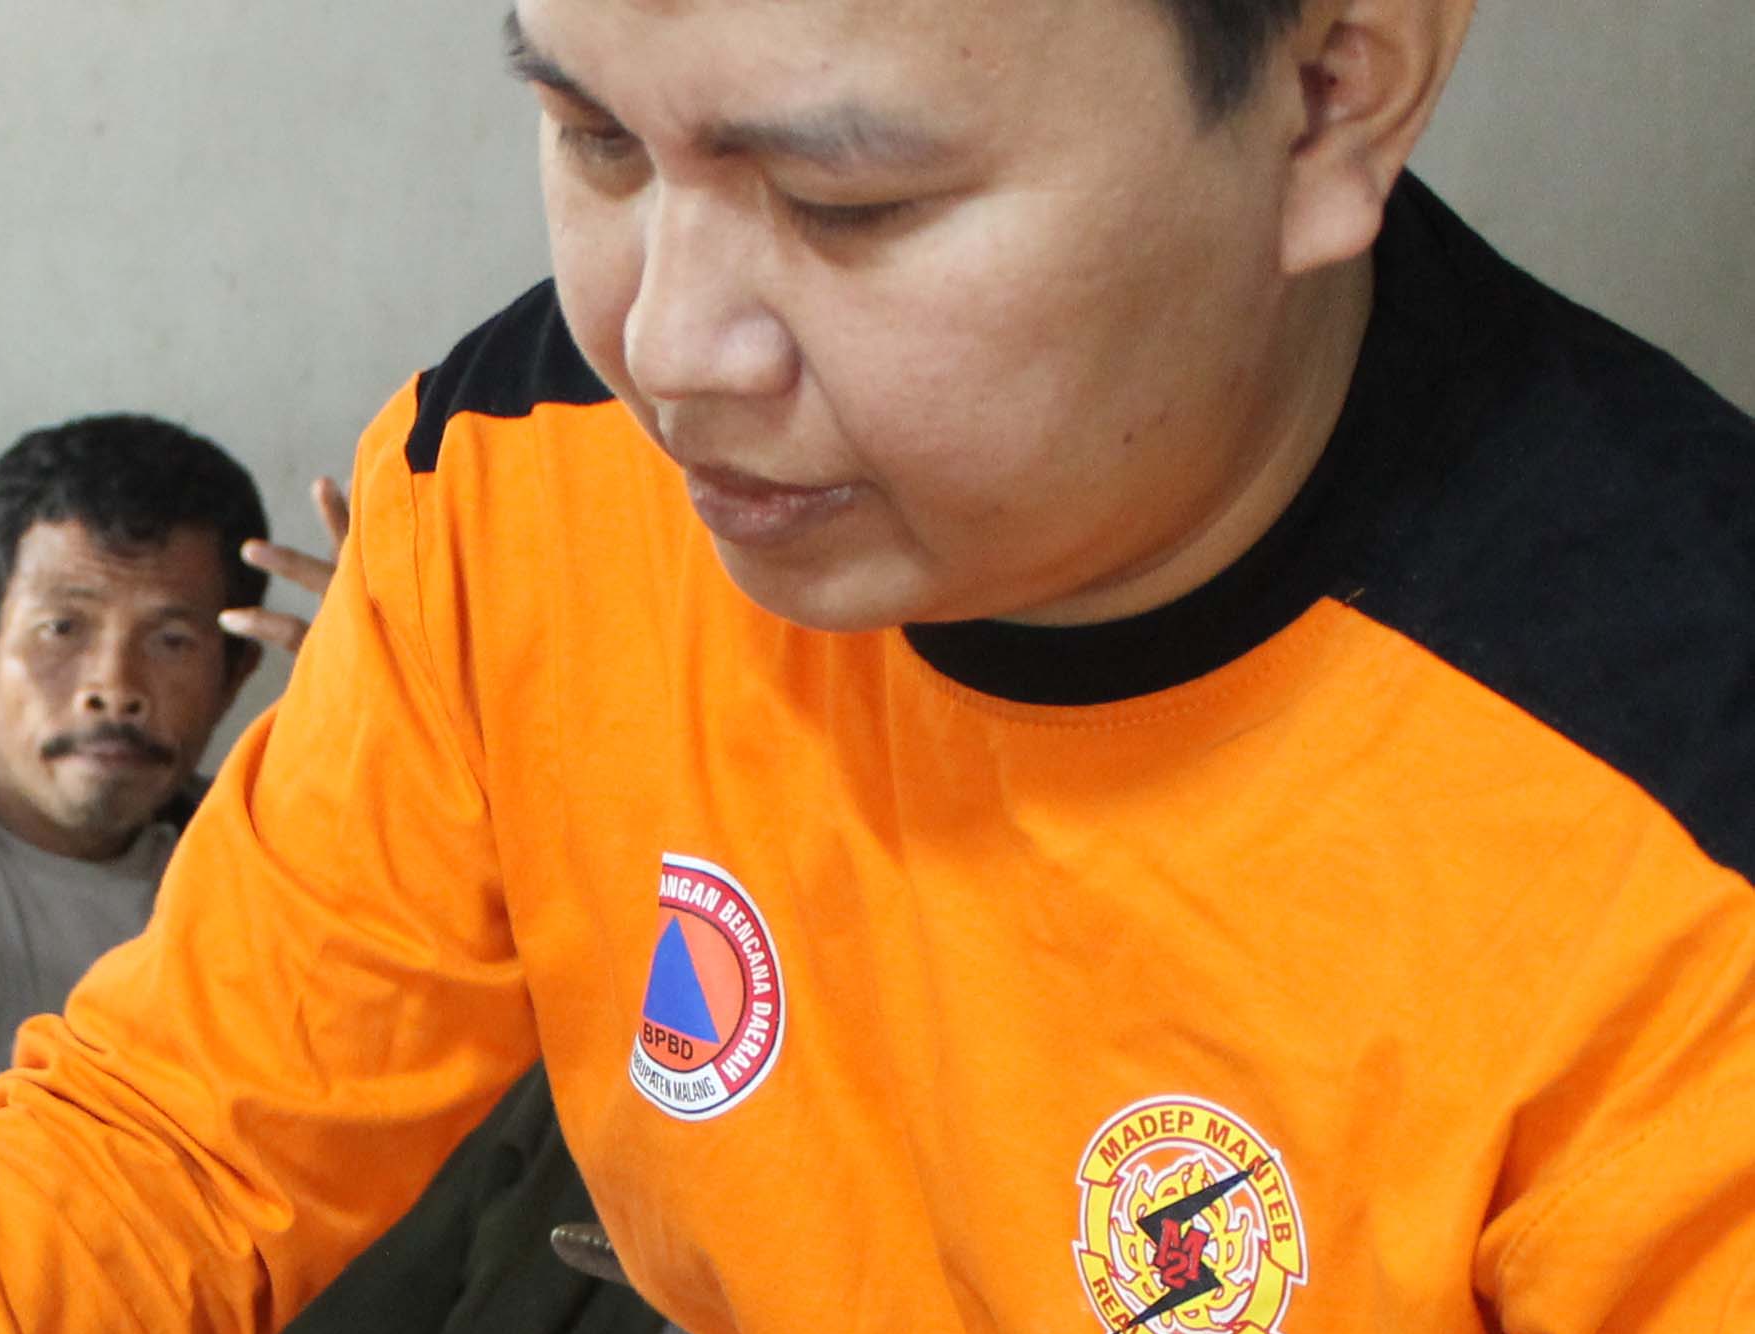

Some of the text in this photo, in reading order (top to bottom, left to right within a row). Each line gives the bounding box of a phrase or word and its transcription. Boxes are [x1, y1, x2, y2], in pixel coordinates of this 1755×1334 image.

[717, 900, 772, 995] BENCANA
[642, 1021, 694, 1060] BPBD
[720, 1002, 773, 1082] DAERAH
[673, 1076, 717, 1102] MALANG
[1099, 1110, 1292, 1243] MADEP MANTEB
